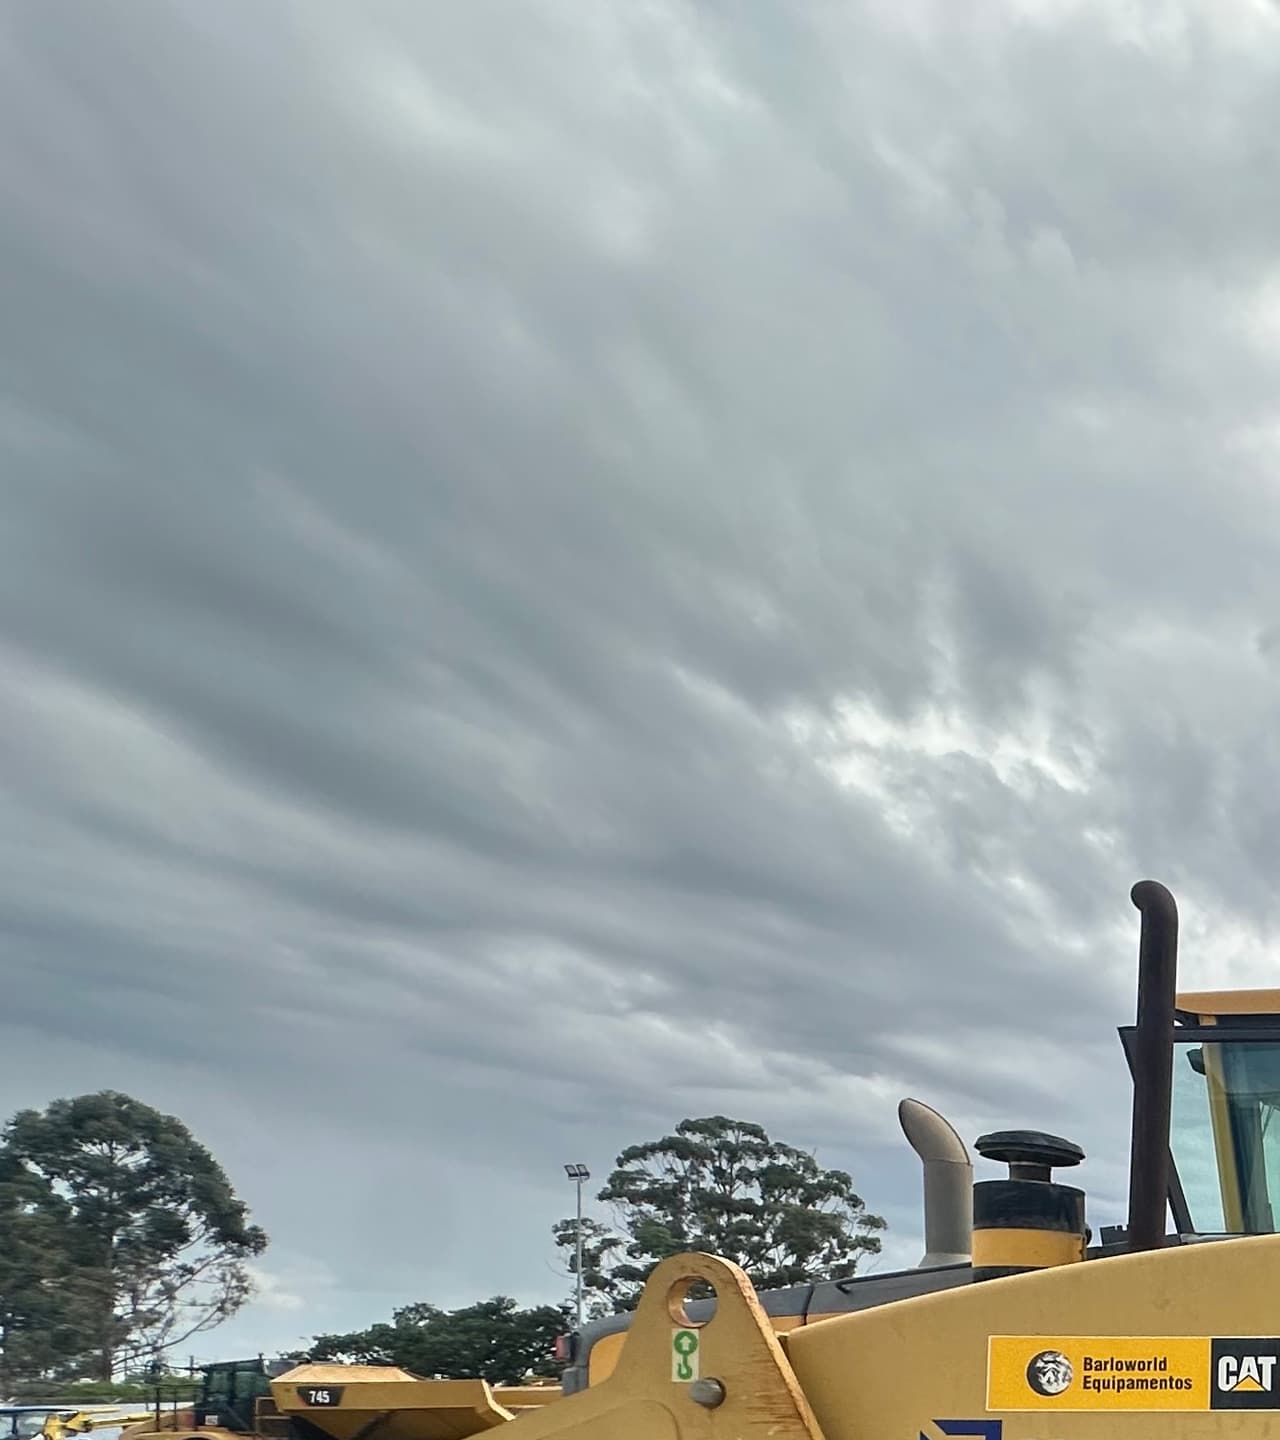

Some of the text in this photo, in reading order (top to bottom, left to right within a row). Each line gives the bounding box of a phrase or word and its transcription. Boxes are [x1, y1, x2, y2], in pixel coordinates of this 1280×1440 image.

[1083, 1357, 1168, 1372] Barloworld
[1217, 1355, 1277, 1392] CAT
[1083, 1375, 1193, 1393] Equipamentos
[308, 1390, 330, 1404] 745
